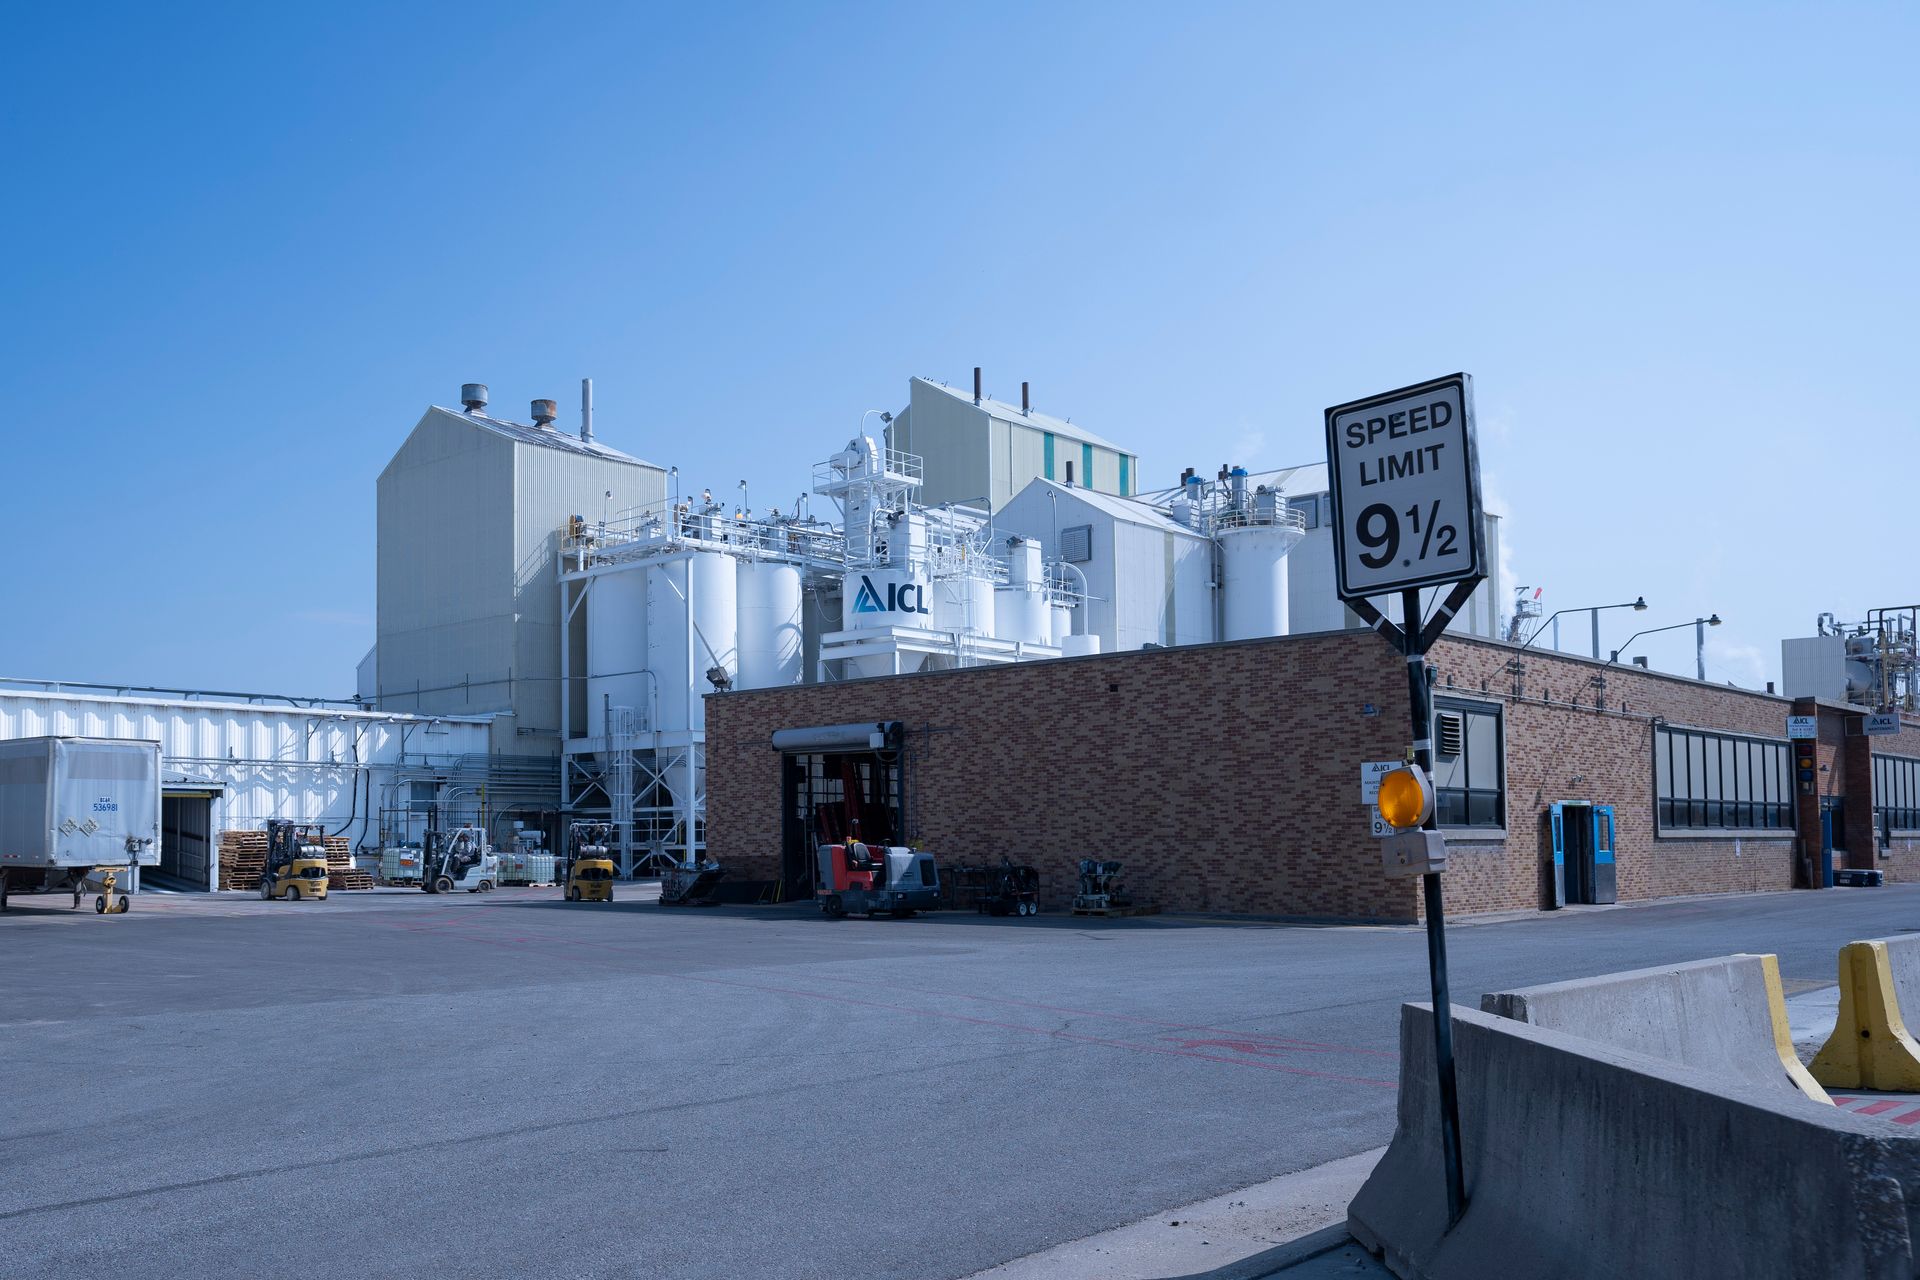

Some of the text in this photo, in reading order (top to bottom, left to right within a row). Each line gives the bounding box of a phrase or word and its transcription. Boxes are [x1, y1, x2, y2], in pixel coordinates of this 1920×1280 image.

[1346, 401, 1453, 448] SPEED
[1359, 443, 1445, 487] LIMIT
[887, 582, 929, 615] ICL
[93, 803, 118, 812] 536981
